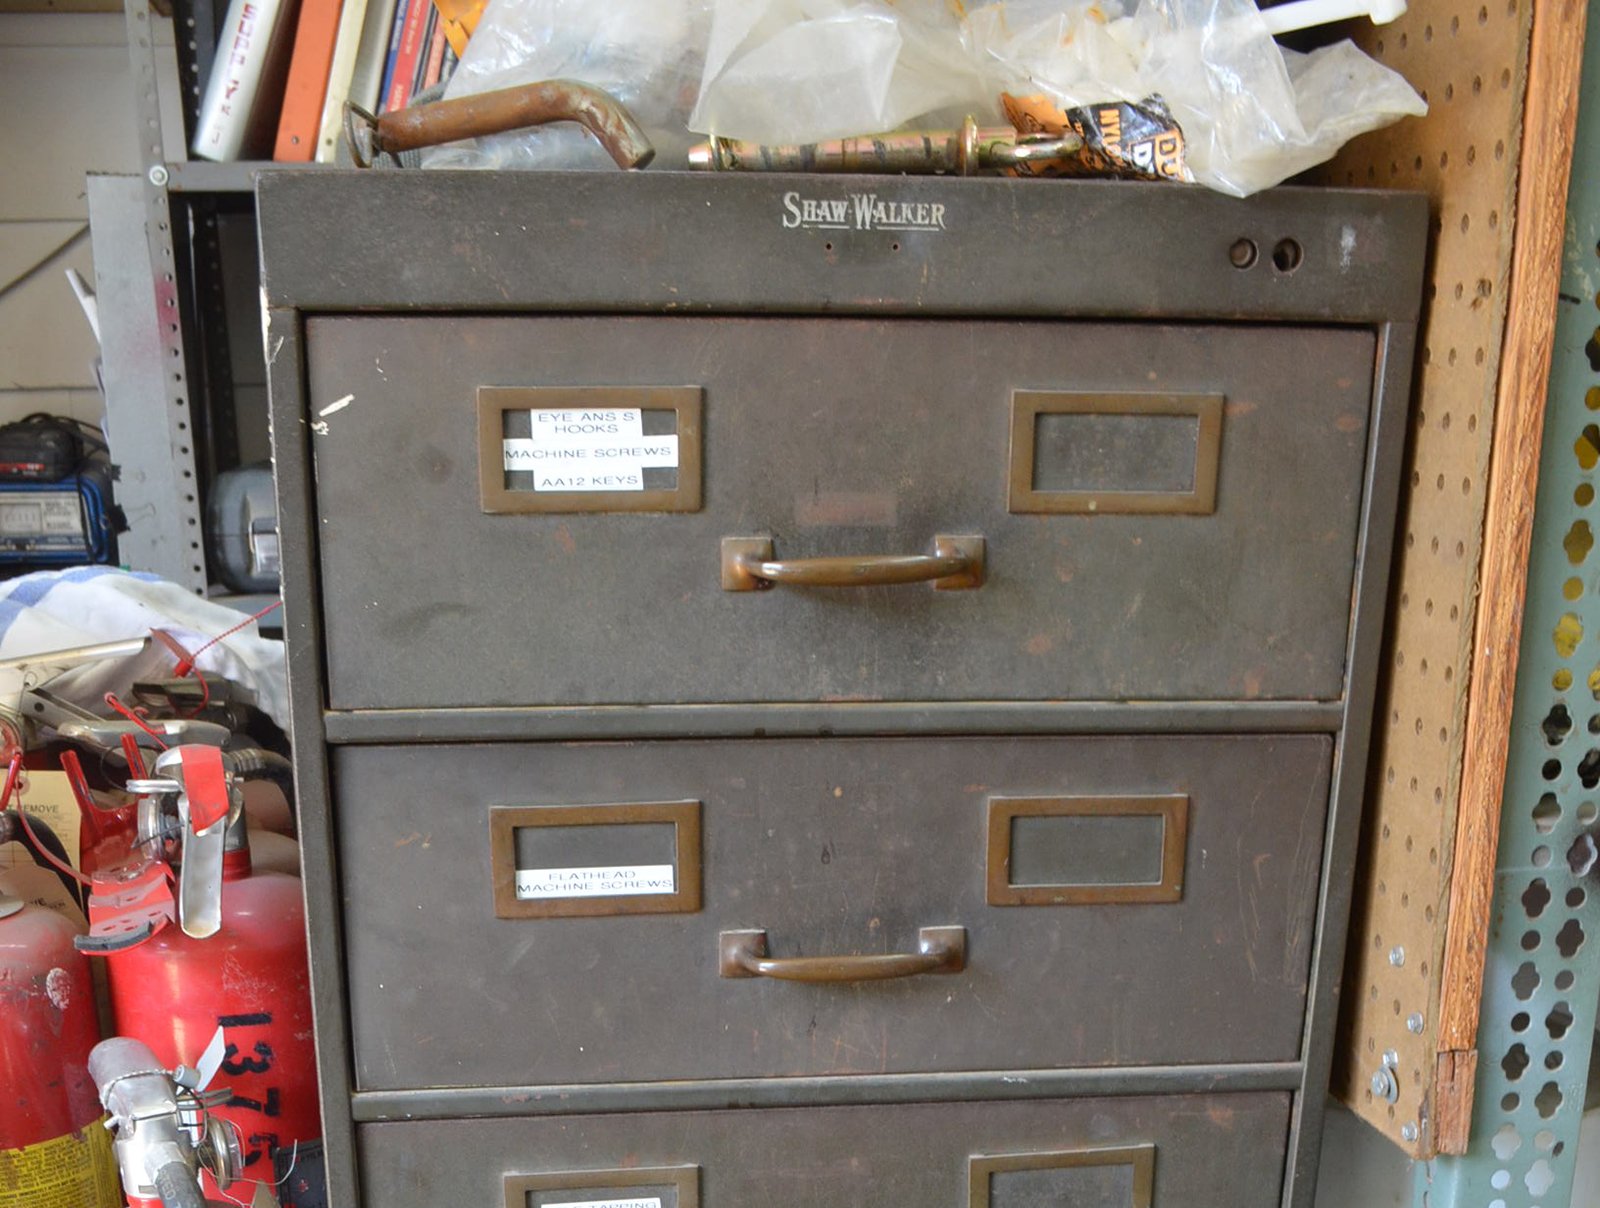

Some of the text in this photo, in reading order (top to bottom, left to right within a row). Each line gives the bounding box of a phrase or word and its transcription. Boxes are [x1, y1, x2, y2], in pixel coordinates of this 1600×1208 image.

[538, 412, 573, 423] EYE
[554, 424, 619, 434] HOOKS
[505, 446, 672, 460] MACHINE SCREWS
[541, 475, 639, 487] AA12 KEYS
[549, 870, 636, 881] FLATHEAD
[517, 879, 673, 893] MACHINE SCREWS
